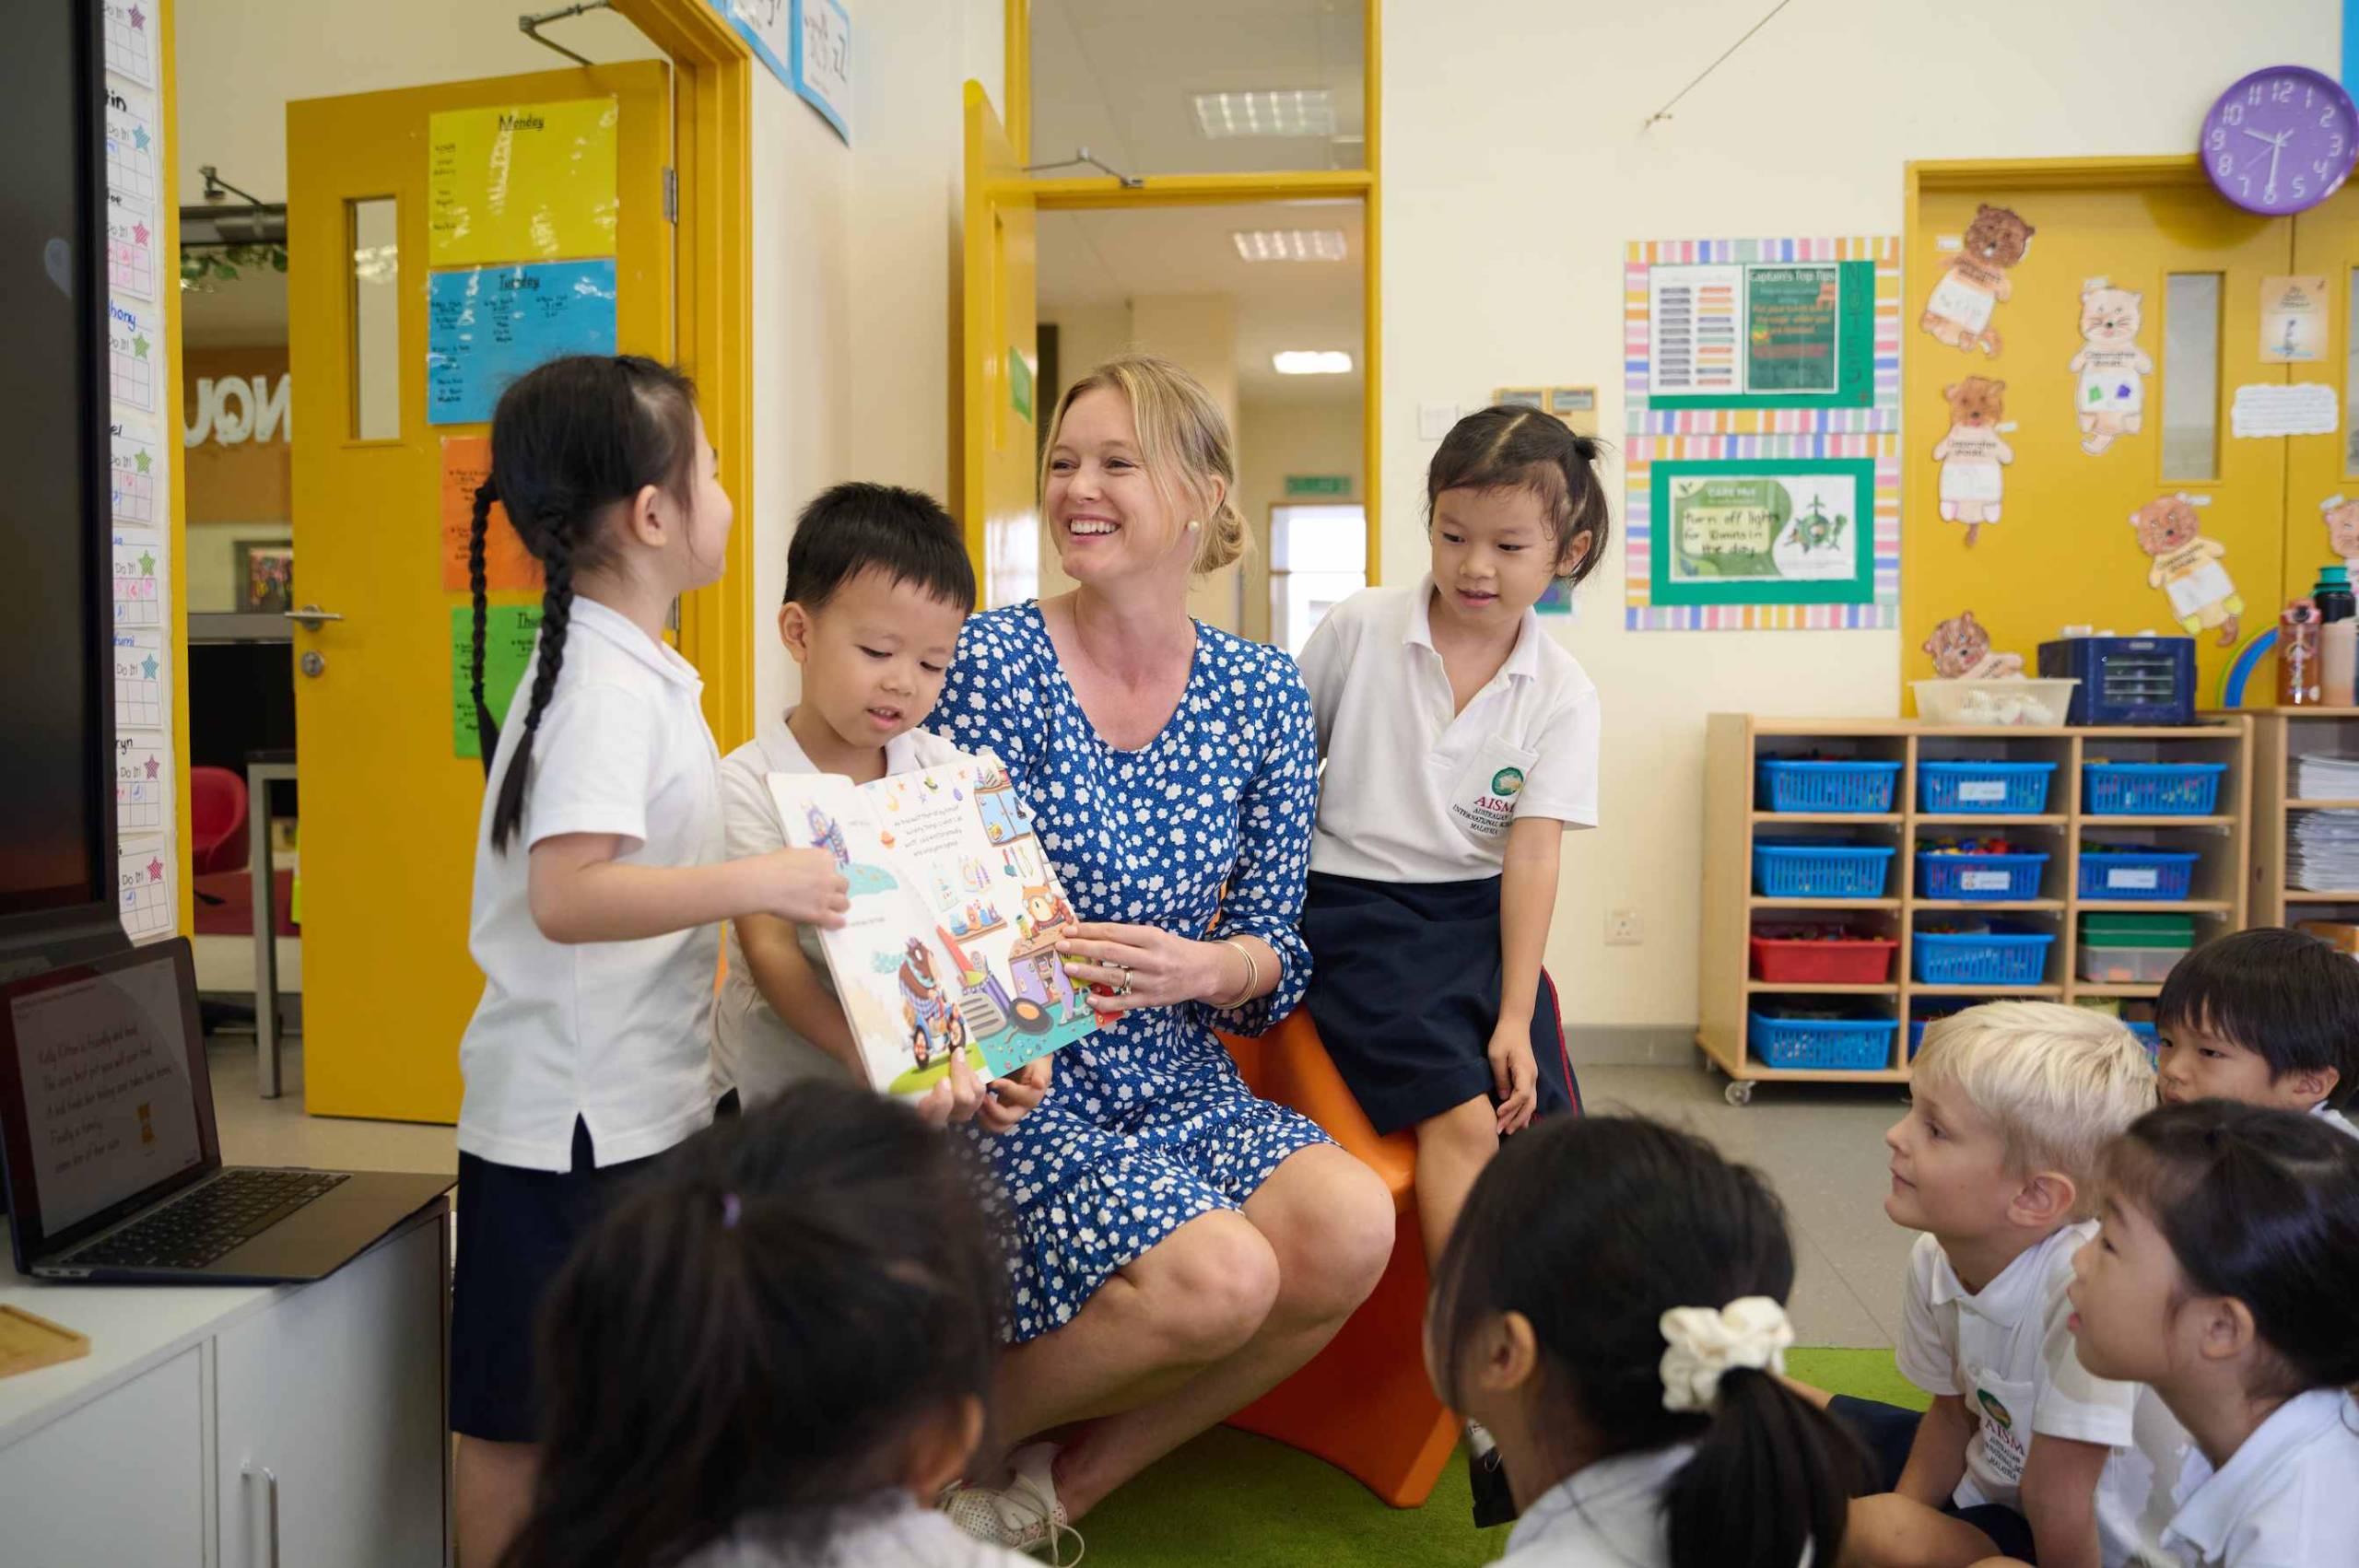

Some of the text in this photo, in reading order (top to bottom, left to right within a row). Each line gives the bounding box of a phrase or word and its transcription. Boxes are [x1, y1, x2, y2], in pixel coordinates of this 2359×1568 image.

[2248, 84, 2262, 105] 11
[2271, 80, 2294, 102] 12
[2306, 87, 2314, 109] 1
[499, 114, 544, 131] Monday
[2223, 103, 2243, 125] 10
[2320, 106, 2336, 127] 2
[2212, 127, 2226, 151] 9
[2328, 134, 2343, 157] 3
[2218, 154, 2233, 177] 8
[2313, 159, 2329, 181] 4
[2238, 176, 2250, 198] 7
[2292, 177, 2306, 199] 5
[1473, 796, 1517, 813] AISM
